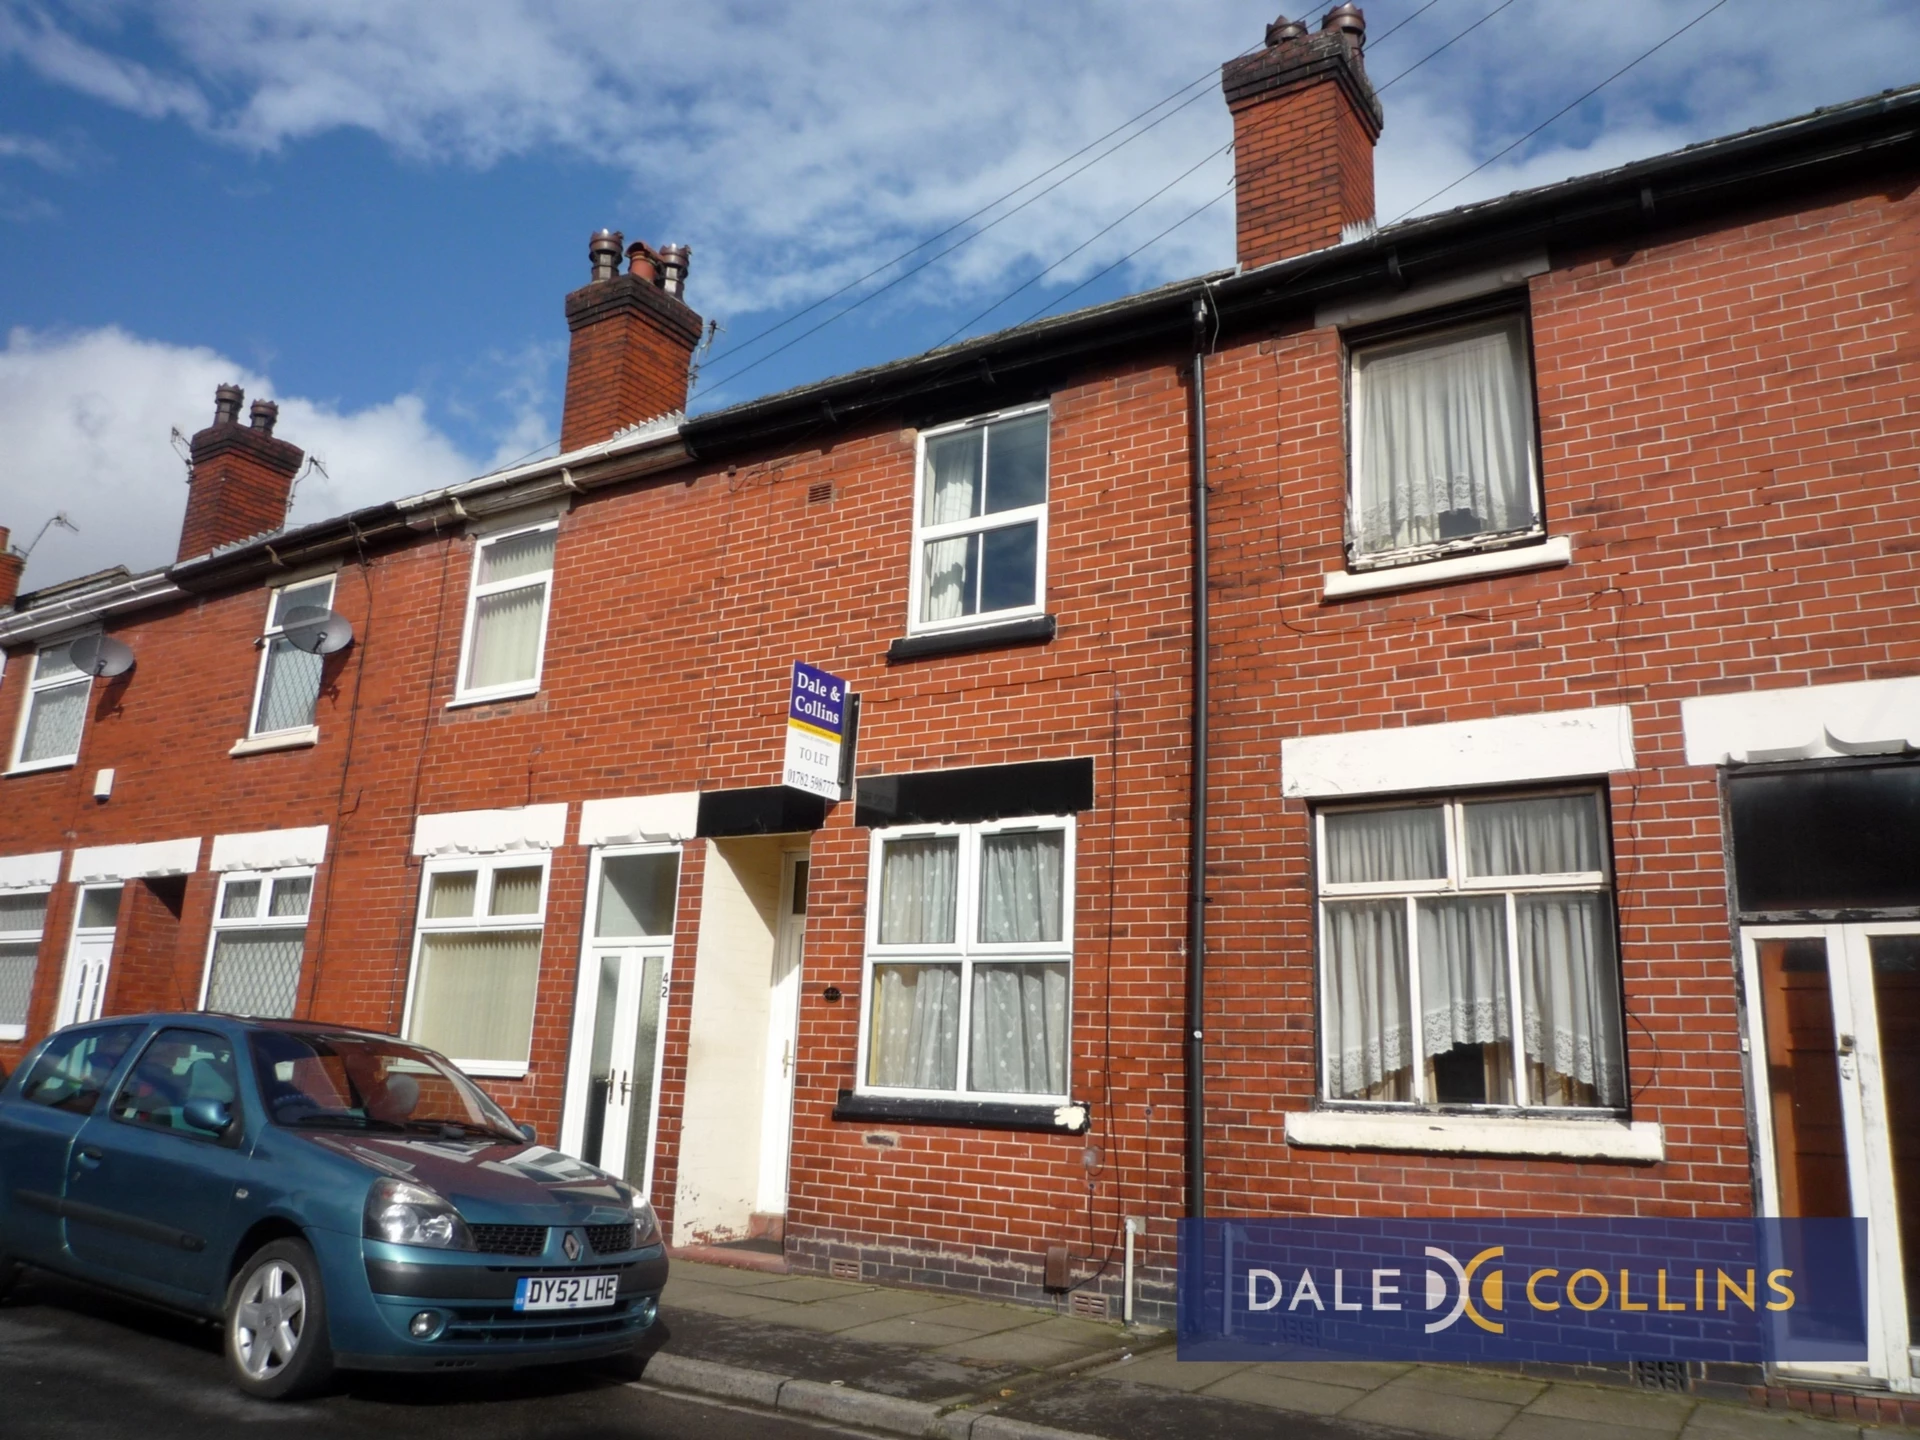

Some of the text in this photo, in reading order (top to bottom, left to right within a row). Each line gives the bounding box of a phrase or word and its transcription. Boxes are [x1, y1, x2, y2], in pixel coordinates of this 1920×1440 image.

[797, 672, 841, 702] Dale &
[795, 695, 839, 724] Collins
[799, 746, 830, 767] TO LET
[787, 768, 809, 787] 01782
[661, 972, 669, 998] 42
[528, 1277, 616, 1303] DY52 LHE
